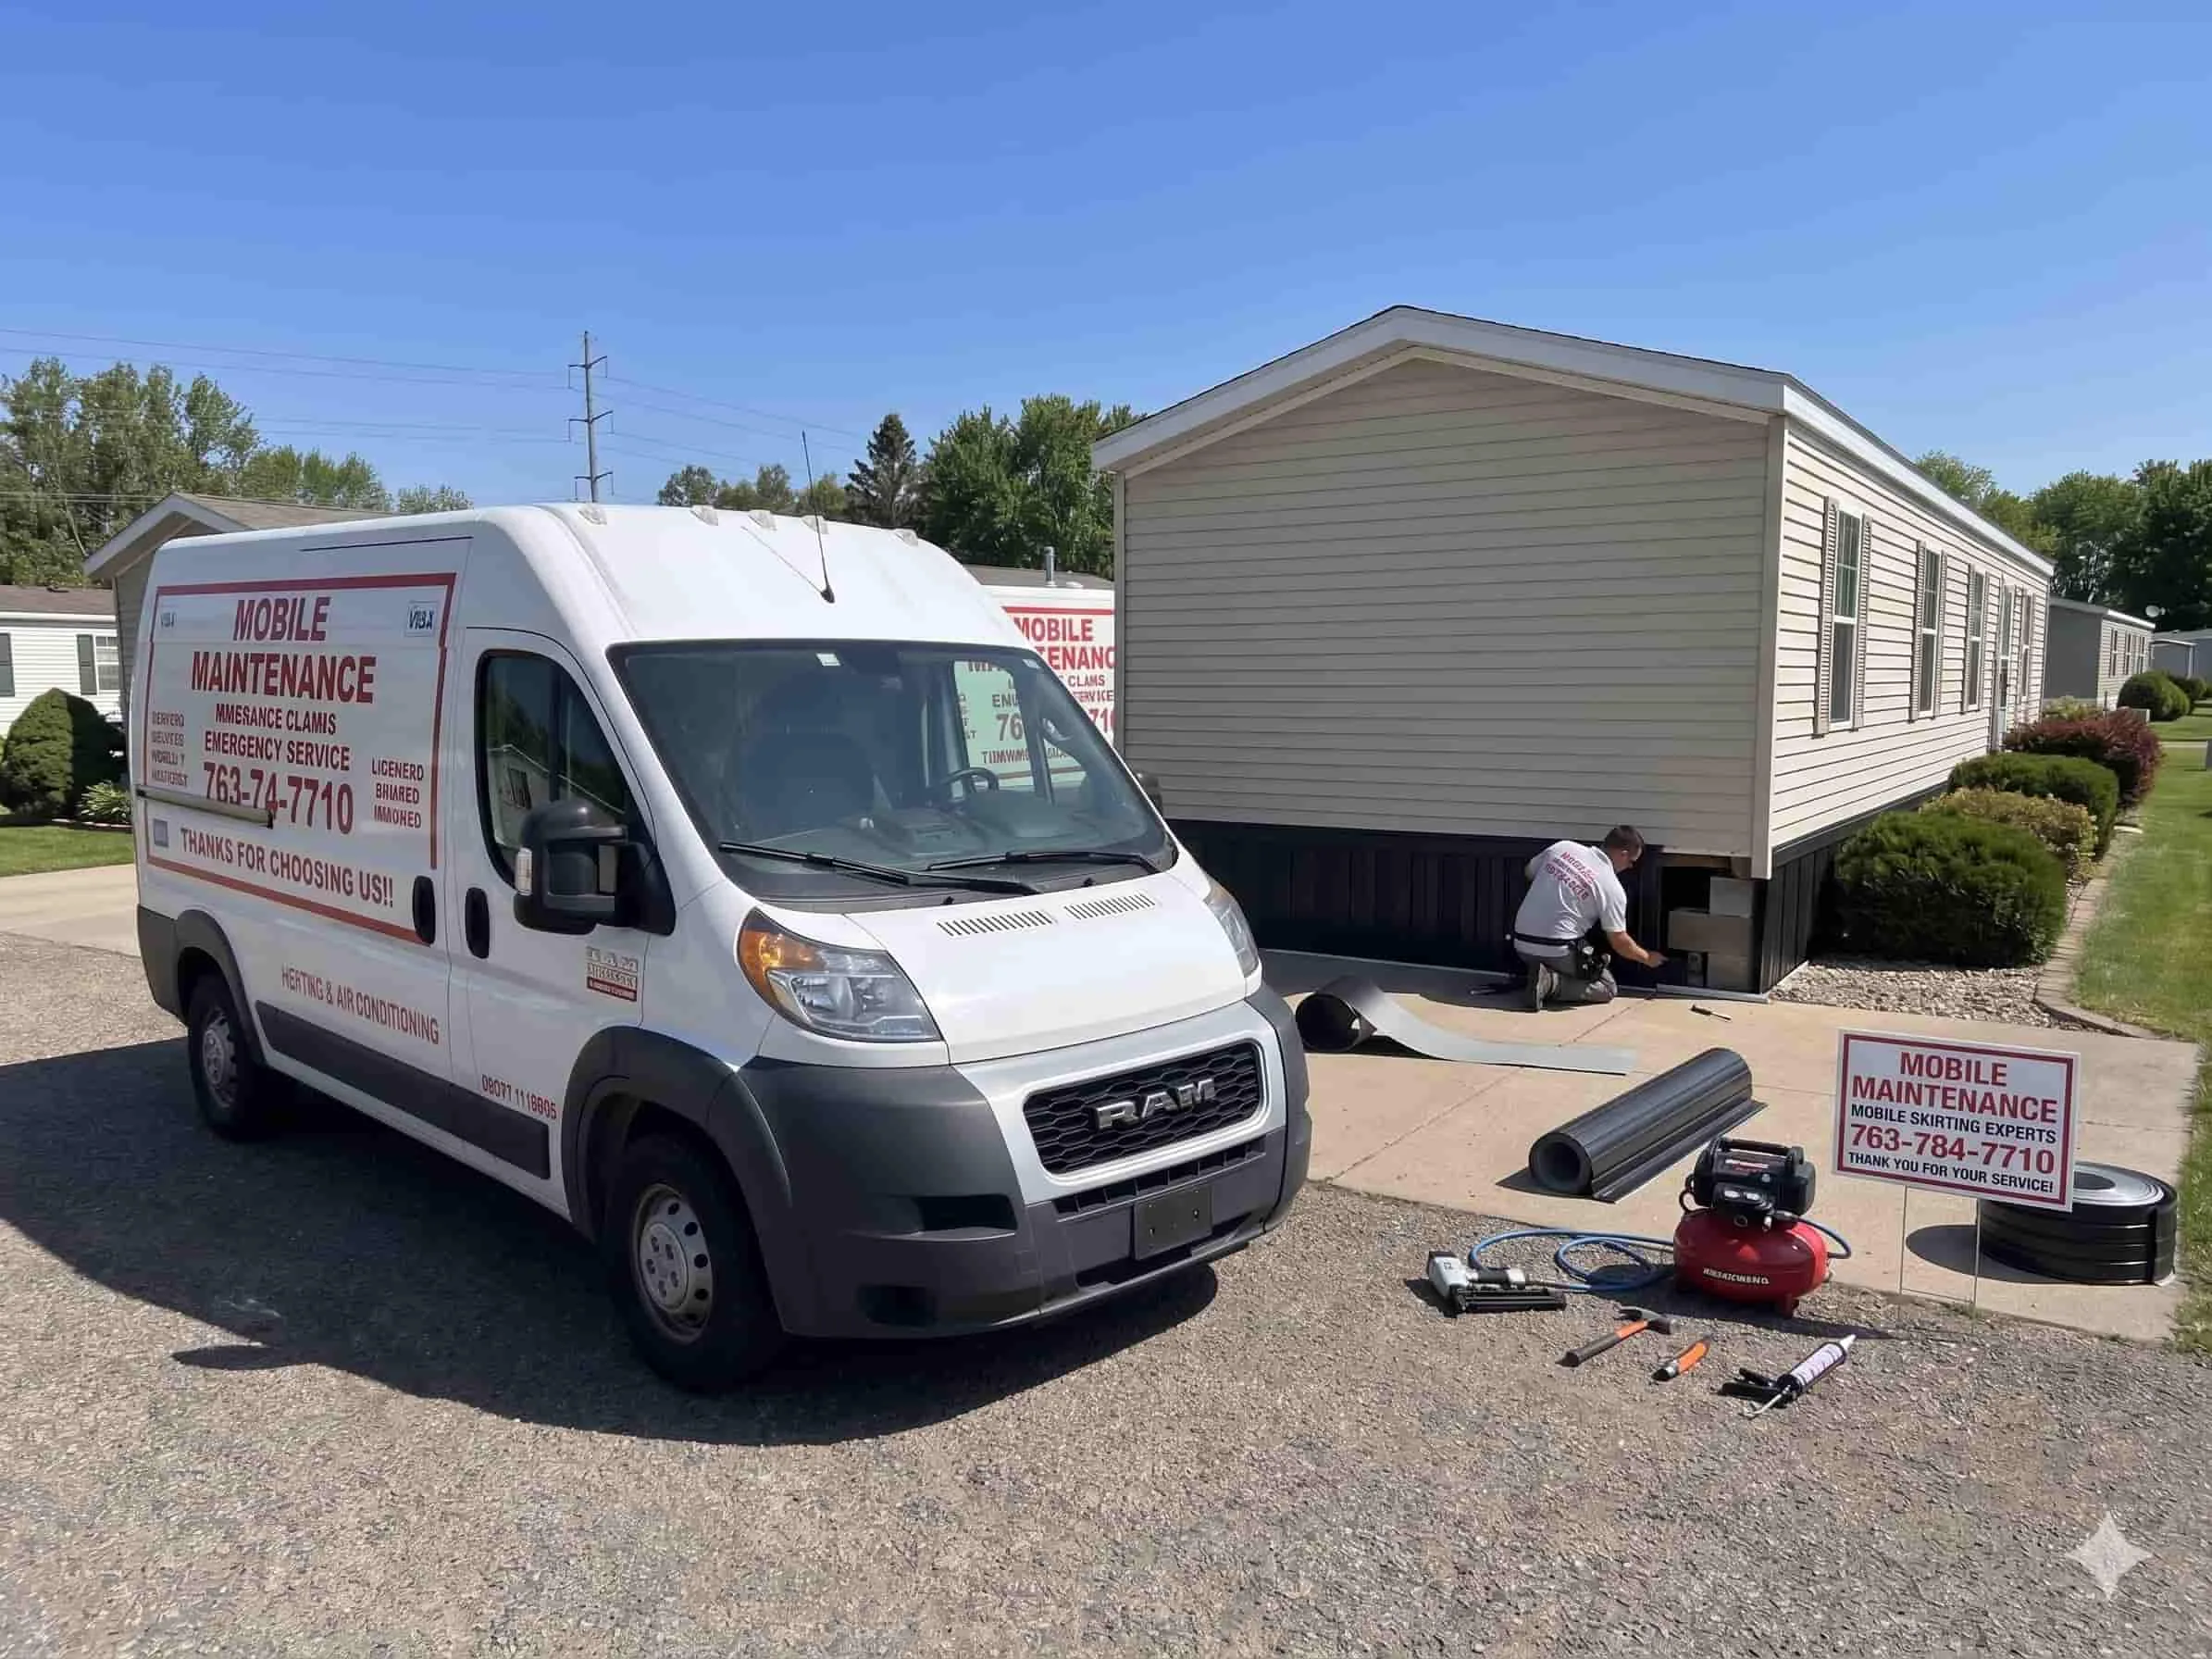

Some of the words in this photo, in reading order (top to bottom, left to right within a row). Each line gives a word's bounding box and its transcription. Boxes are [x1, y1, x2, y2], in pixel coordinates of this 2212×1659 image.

[233, 596, 331, 641] MOBILE
[1013, 617, 1094, 642] MOBILE
[192, 651, 377, 704] MAINTENANCE
[205, 730, 282, 762] EMERGENCY
[287, 740, 350, 771] SERVICE
[204, 762, 354, 835] 763-74-7710
[181, 828, 232, 864] THANKS
[237, 842, 267, 873] FOR
[270, 850, 354, 897] CHOOSING
[359, 870, 393, 908] US!!
[337, 985, 354, 1014] AIR
[356, 992, 439, 1044] CONDITIONING
[1901, 1052, 2007, 1087] MOBILE
[1096, 1079, 1215, 1129] RAM
[1851, 1104, 1907, 1123] MOBILE
[1909, 1111, 1981, 1134] SKIRTING
[1985, 1121, 2057, 1144] EXPERTS
[1853, 1075, 2057, 1124] MAINTENANCE
[1849, 1152, 1890, 1168] THANK
[1894, 1157, 1919, 1172] YOU
[1922, 1162, 1948, 1178] FOR
[1953, 1166, 1987, 1183] YOUR
[1992, 1173, 2054, 1192] SERVICE!
[1851, 1123, 2055, 1174] 763-784-7710
